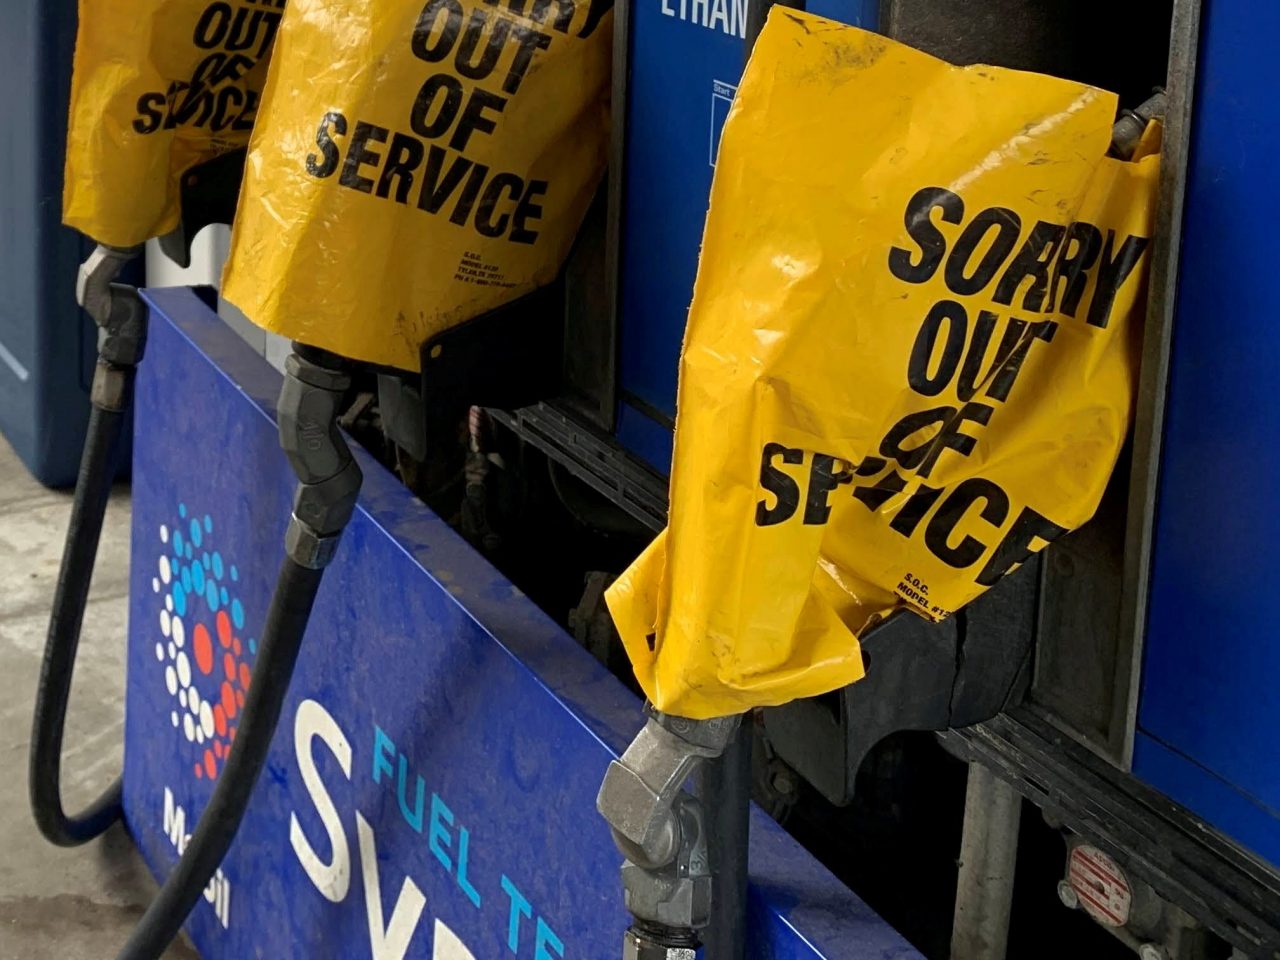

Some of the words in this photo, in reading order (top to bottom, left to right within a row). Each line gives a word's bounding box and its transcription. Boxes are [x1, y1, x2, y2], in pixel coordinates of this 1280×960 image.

[192, 0, 282, 59] OUT
[190, 52, 257, 88] OF
[713, 83, 730, 97] Start
[410, 73, 508, 153] OF
[305, 110, 549, 246] SERVICE
[888, 186, 1148, 329] SORRY
[907, 299, 1060, 403] OUT
[878, 402, 995, 480] OF
[904, 572, 929, 596] S.O.C.
[373, 724, 481, 910] FUEL
